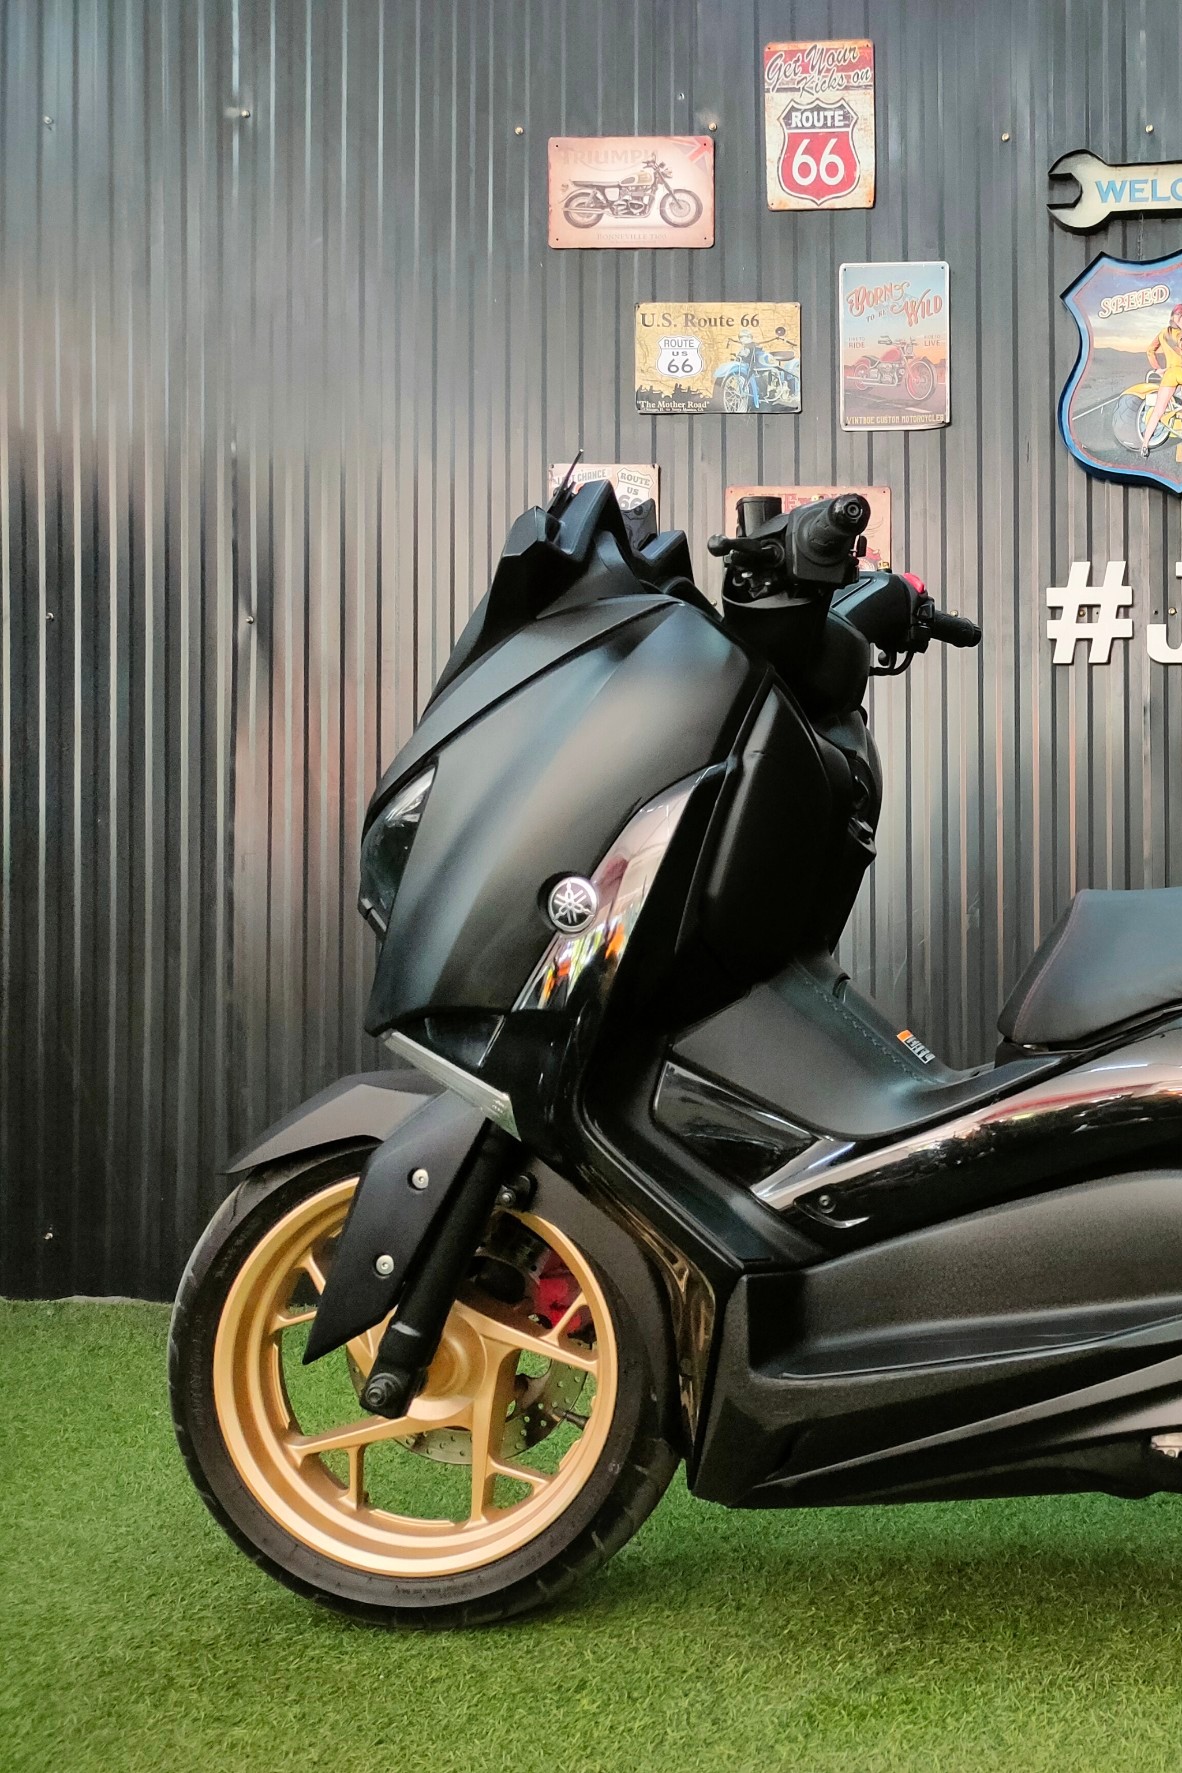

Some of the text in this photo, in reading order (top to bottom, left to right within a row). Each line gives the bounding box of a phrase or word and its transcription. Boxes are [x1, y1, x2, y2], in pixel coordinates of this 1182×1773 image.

[766, 44, 859, 93] Get Your
[797, 67, 871, 98] Kicks on
[791, 110, 844, 128] ROUTE
[560, 149, 659, 164] TRIUMPH
[792, 138, 845, 186] 66
[847, 282, 910, 317] BORN
[1098, 284, 1170, 319] SPEED
[890, 289, 943, 327] WILD
[640, 313, 760, 328] U.S. Route 66
[664, 339, 694, 347] ROUTE
[667, 358, 693, 373] 66
[658, 401, 686, 409] Mother
[876, 416, 900, 424] CUSTOM
[578, 469, 606, 481] CHANCE
[620, 473, 650, 486] ROUTE
[626, 487, 639, 495] US
